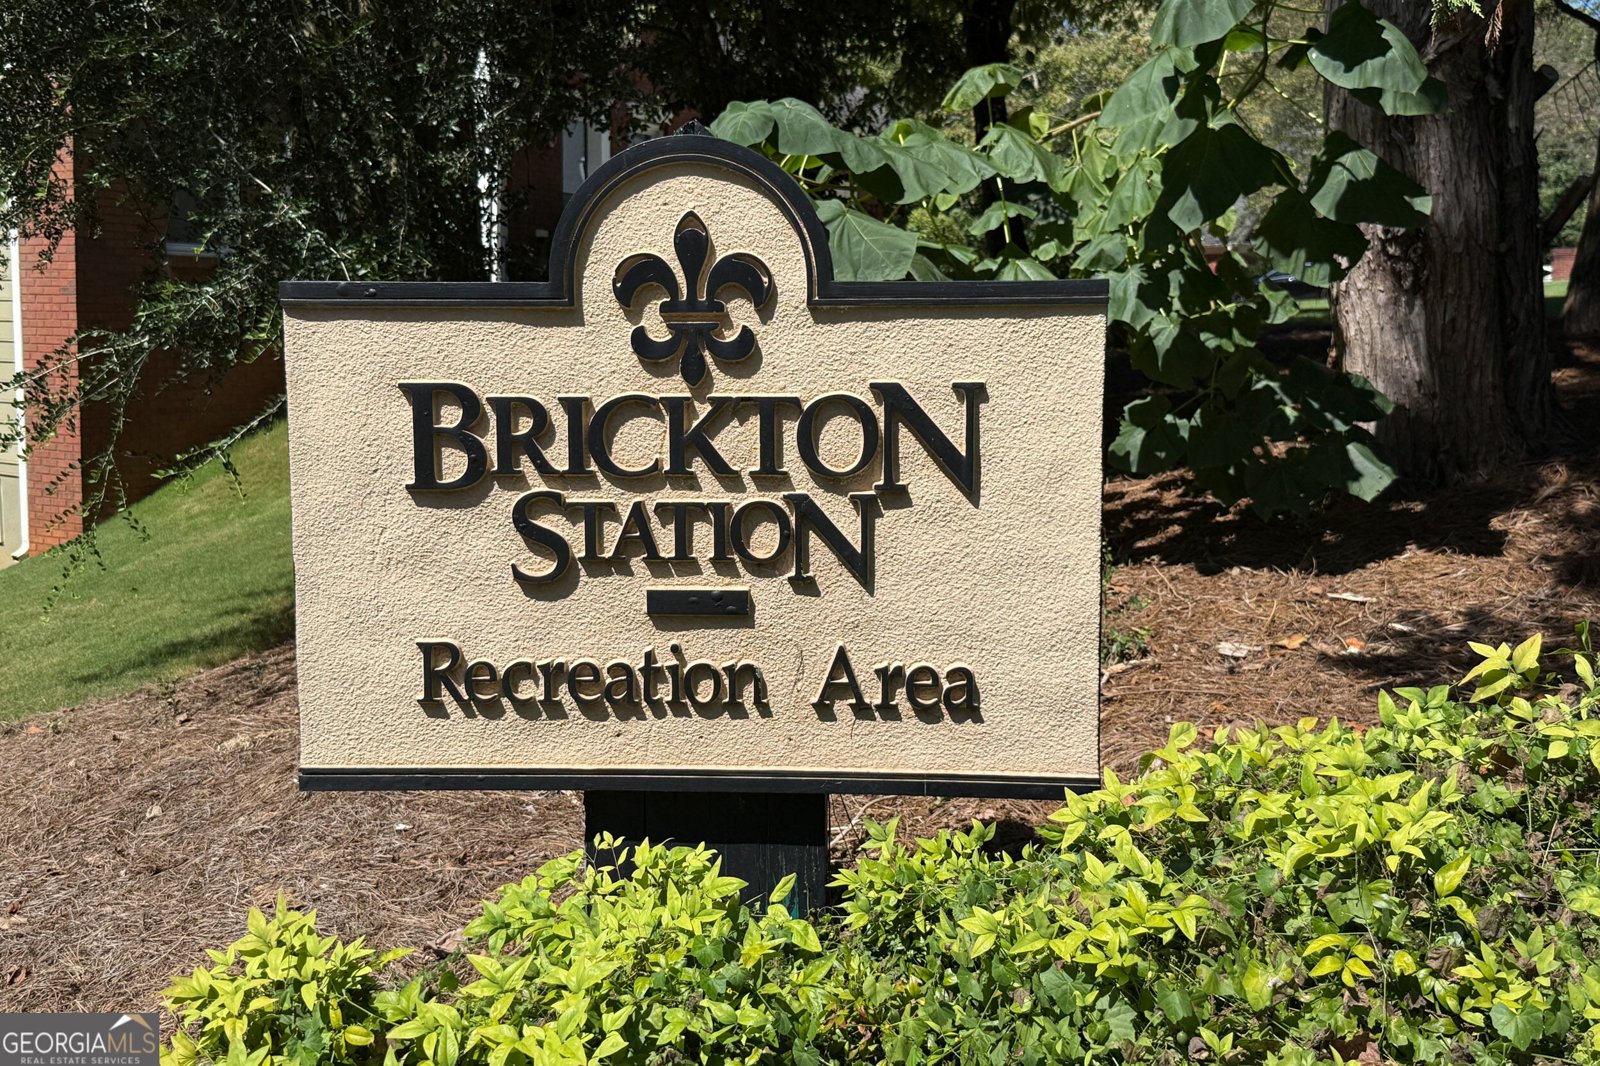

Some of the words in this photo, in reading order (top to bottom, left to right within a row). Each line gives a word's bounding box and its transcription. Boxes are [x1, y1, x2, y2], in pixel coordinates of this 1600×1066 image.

[398, 381, 985, 494] BRICKTON
[510, 490, 877, 590] STATION
[415, 638, 763, 707] Recreation
[817, 642, 979, 710] Area
